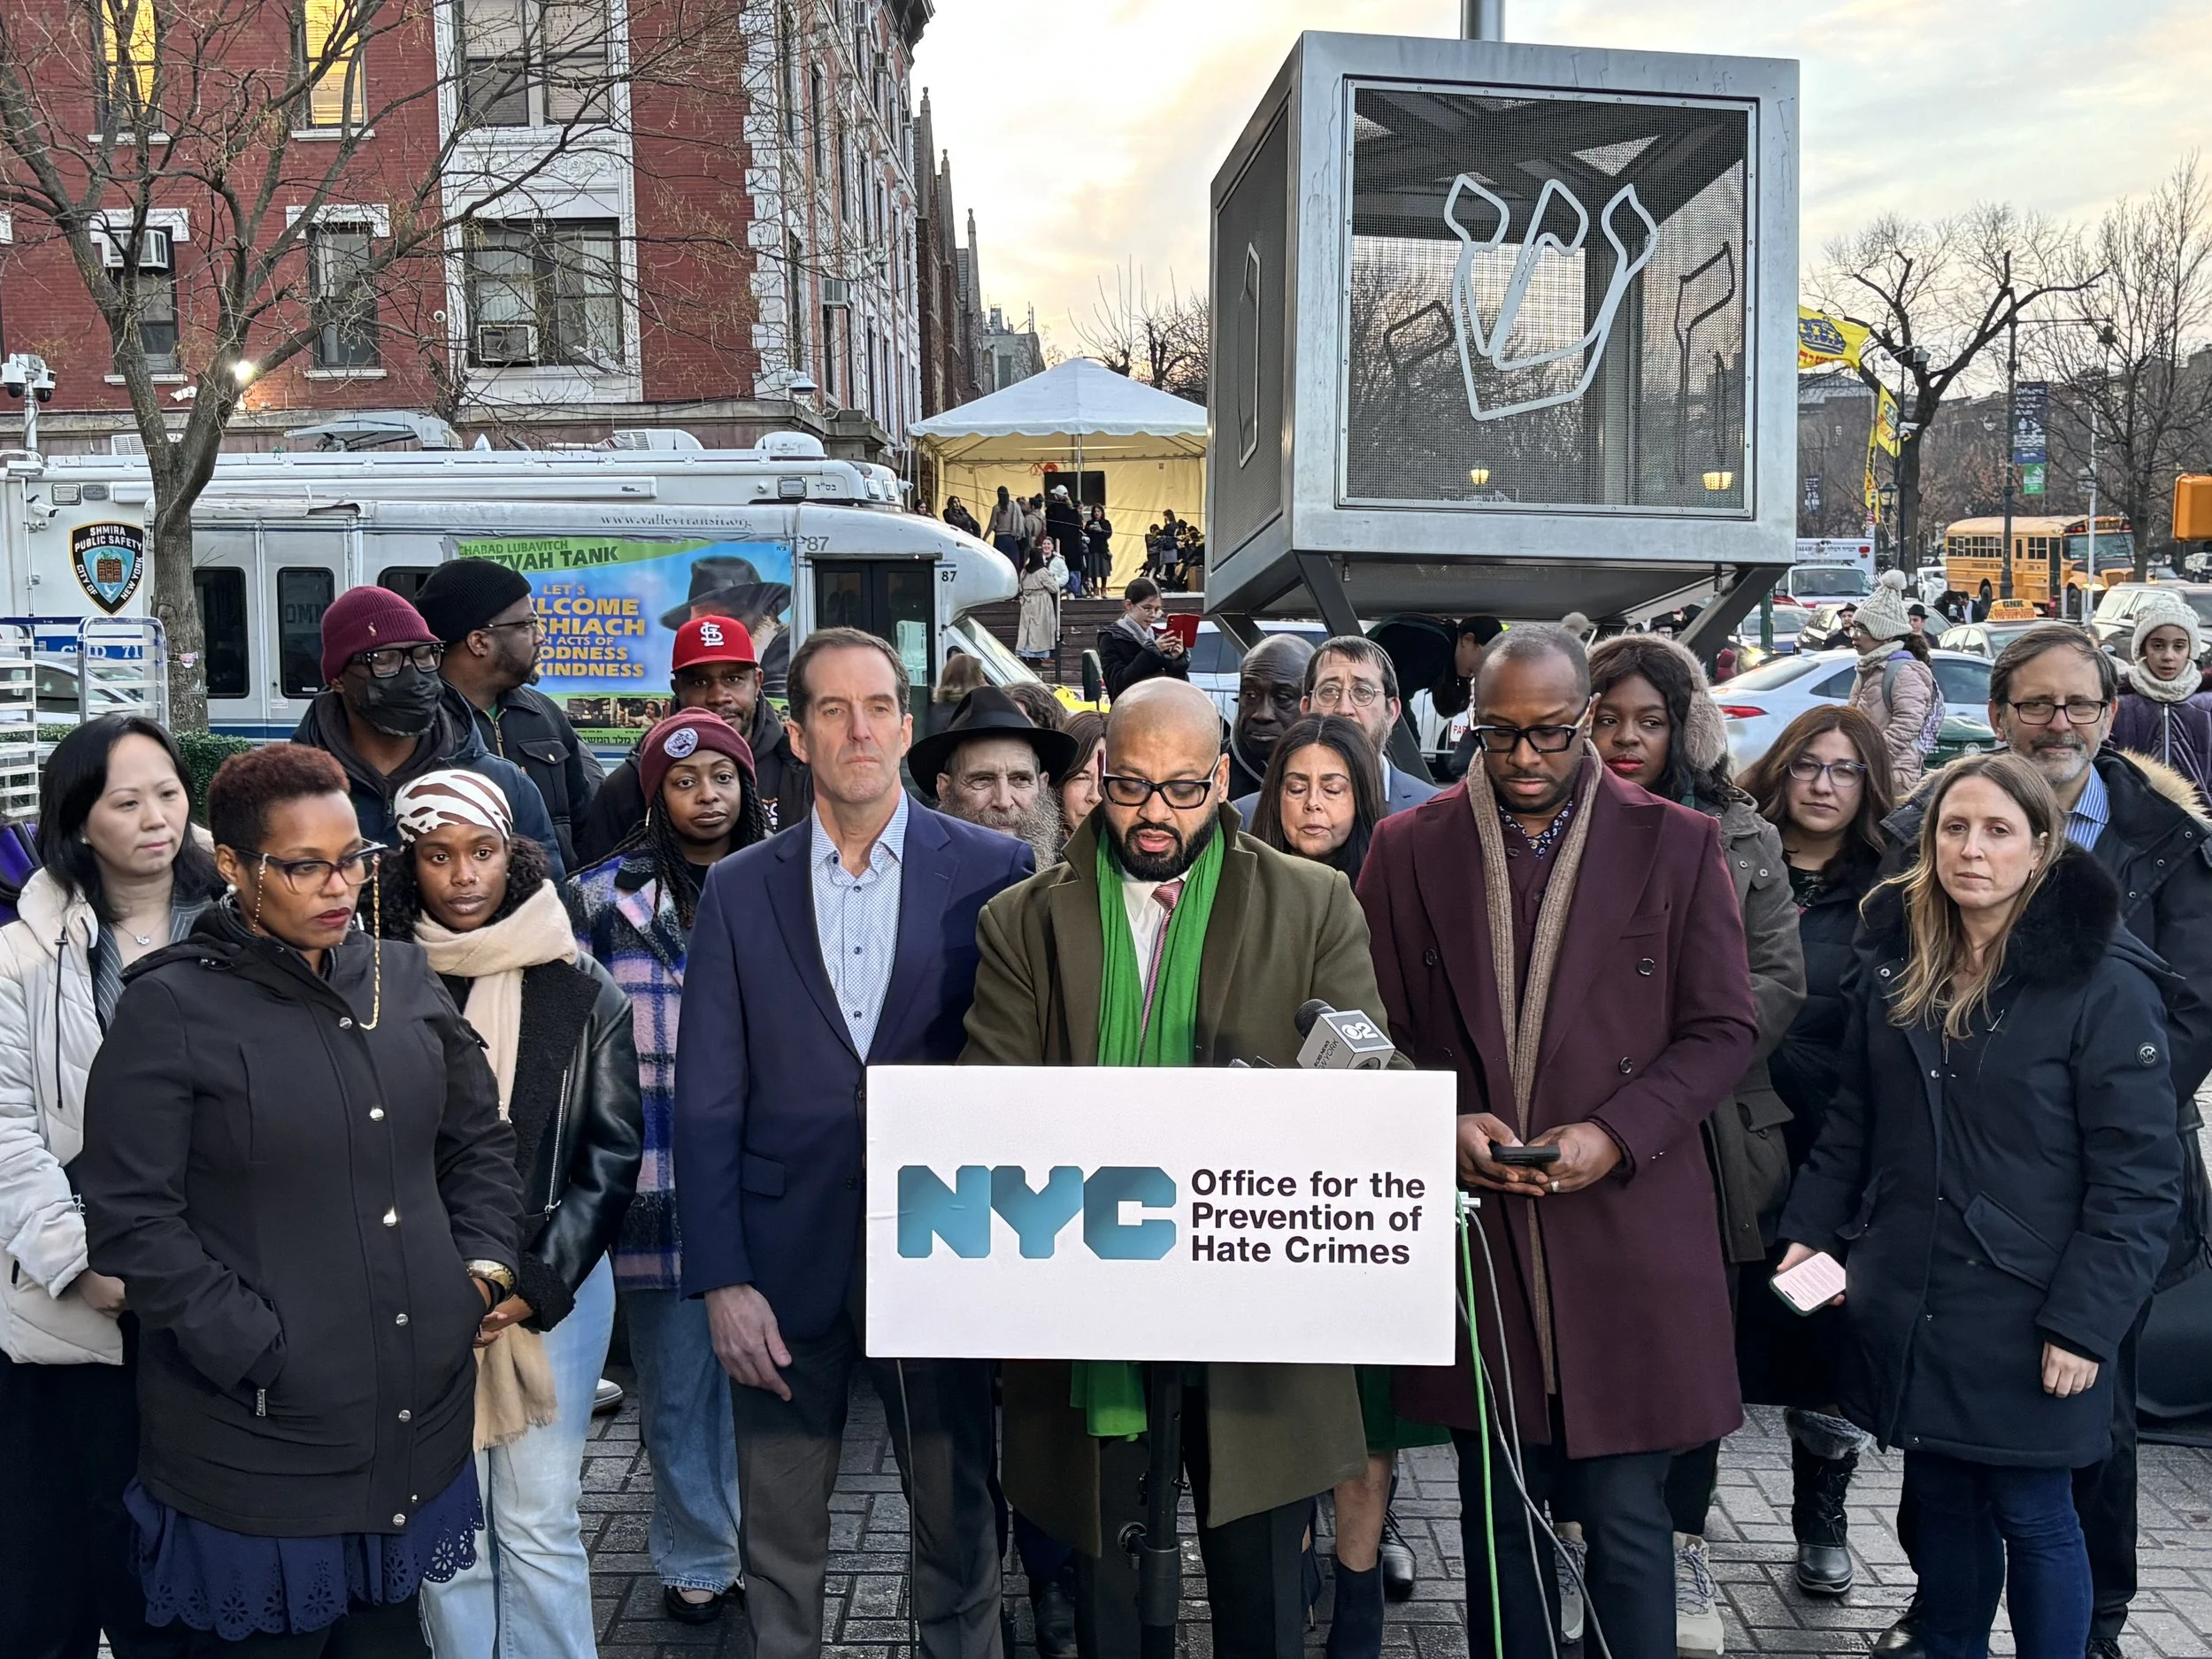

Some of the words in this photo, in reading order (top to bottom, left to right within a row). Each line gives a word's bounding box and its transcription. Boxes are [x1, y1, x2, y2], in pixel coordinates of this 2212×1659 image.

[89, 526, 126, 536] SHMIRA
[74, 536, 106, 552] PUBLIC
[108, 535, 142, 550] SAFETY
[459, 543, 503, 555] CHABAD
[507, 540, 568, 553] LUBAVITCH
[807, 536, 829, 551] 87
[560, 545, 618, 567] TANK
[76, 564, 90, 584] CITY
[87, 584, 98, 595] OF
[120, 580, 135, 600] NEW
[131, 557, 143, 580] YORK
[941, 571, 957, 582] 87
[542, 582, 586, 595] LET'S
[533, 597, 639, 616] LCOME
[538, 618, 645, 635] SHIACH
[557, 636, 590, 645] ACTS
[595, 636, 614, 645] OF
[122, 645, 140, 658] 71
[540, 646, 627, 660] ODNESS
[1324, 1038, 1339, 1060] YORK
[897, 1165, 1177, 1260] NYC
[1191, 1169, 1297, 1197] Office
[1310, 1169, 1357, 1197] for
[1370, 1171, 1425, 1198] the
[1192, 1202, 1374, 1231] Prevention
[1389, 1205, 1423, 1232] of
[1192, 1235, 1271, 1262] Hate
[1285, 1235, 1410, 1264] Crimes
